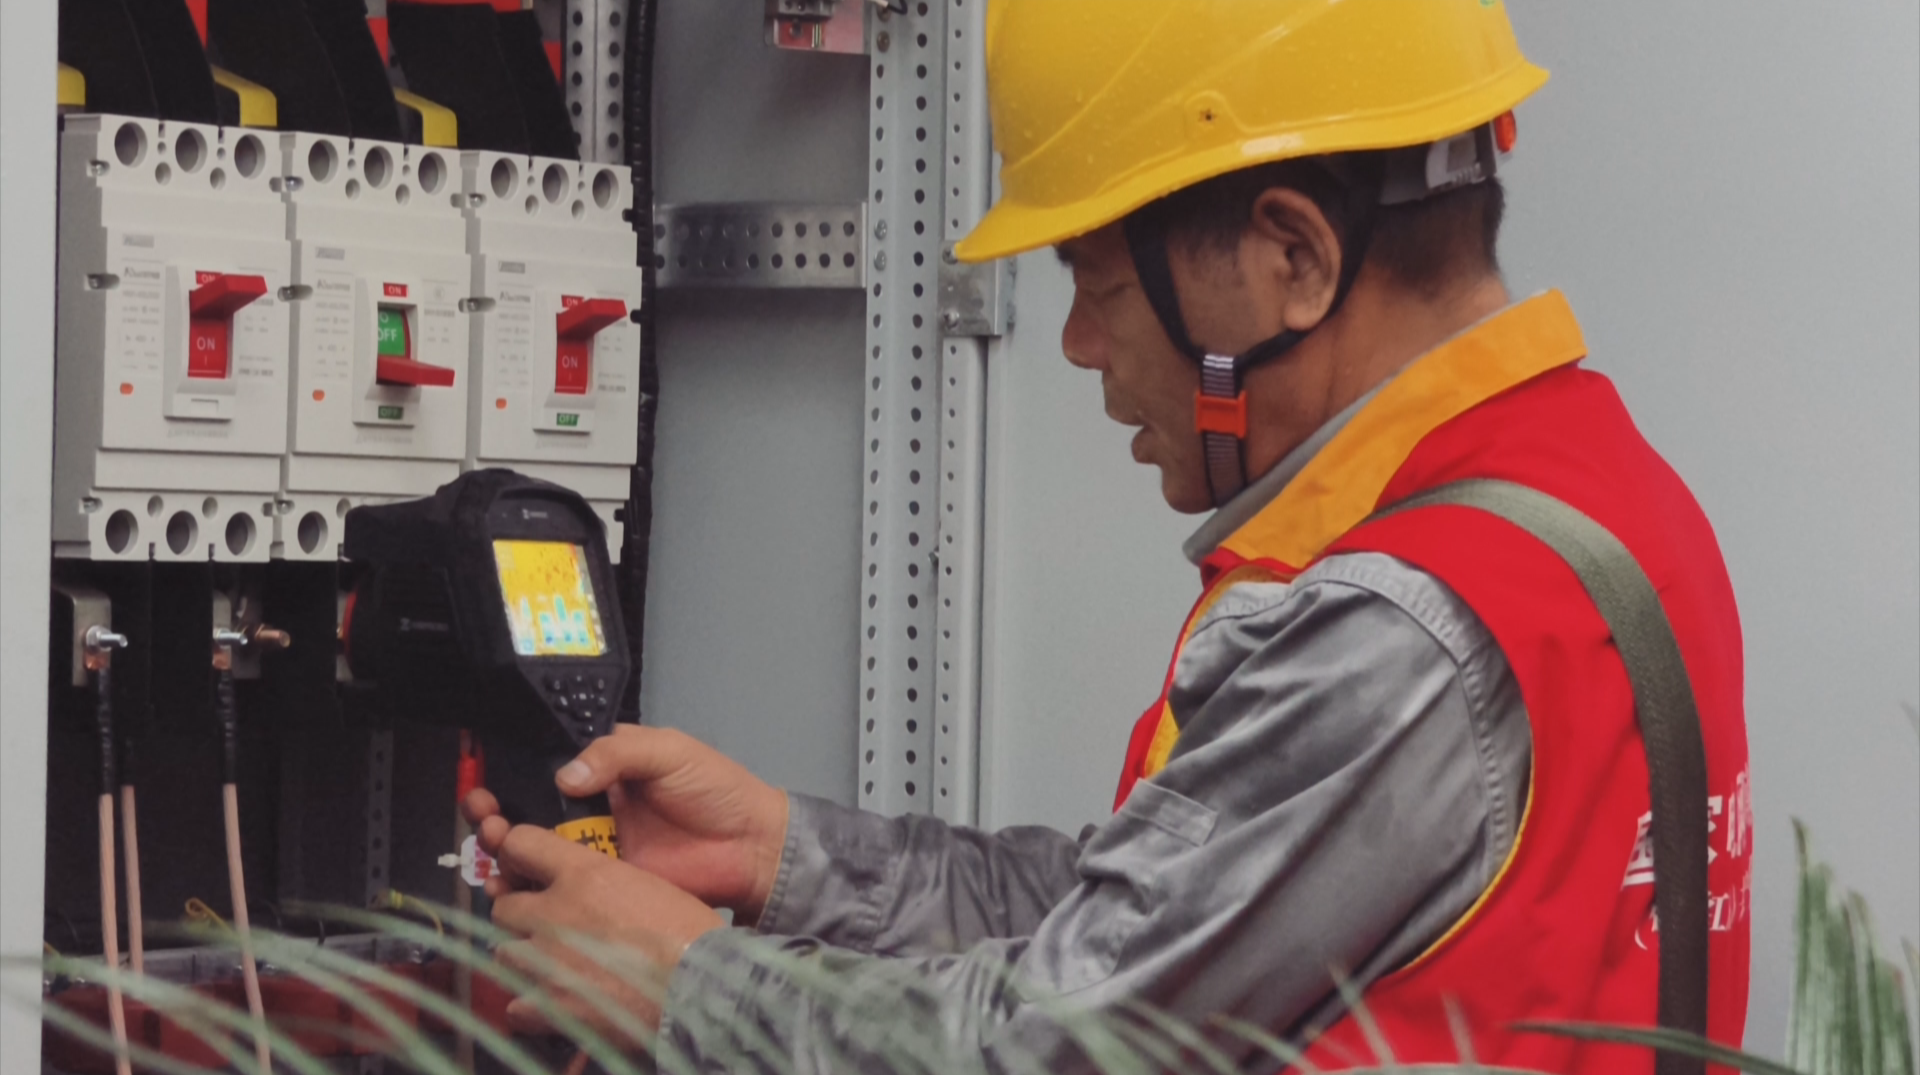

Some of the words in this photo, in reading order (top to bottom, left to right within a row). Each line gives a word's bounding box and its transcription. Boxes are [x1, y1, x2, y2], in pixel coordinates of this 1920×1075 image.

[388, 285, 402, 296] ON
[566, 298, 579, 307] ON
[197, 336, 216, 350] ON
[562, 355, 579, 369] ON
[559, 414, 576, 423] OFF
